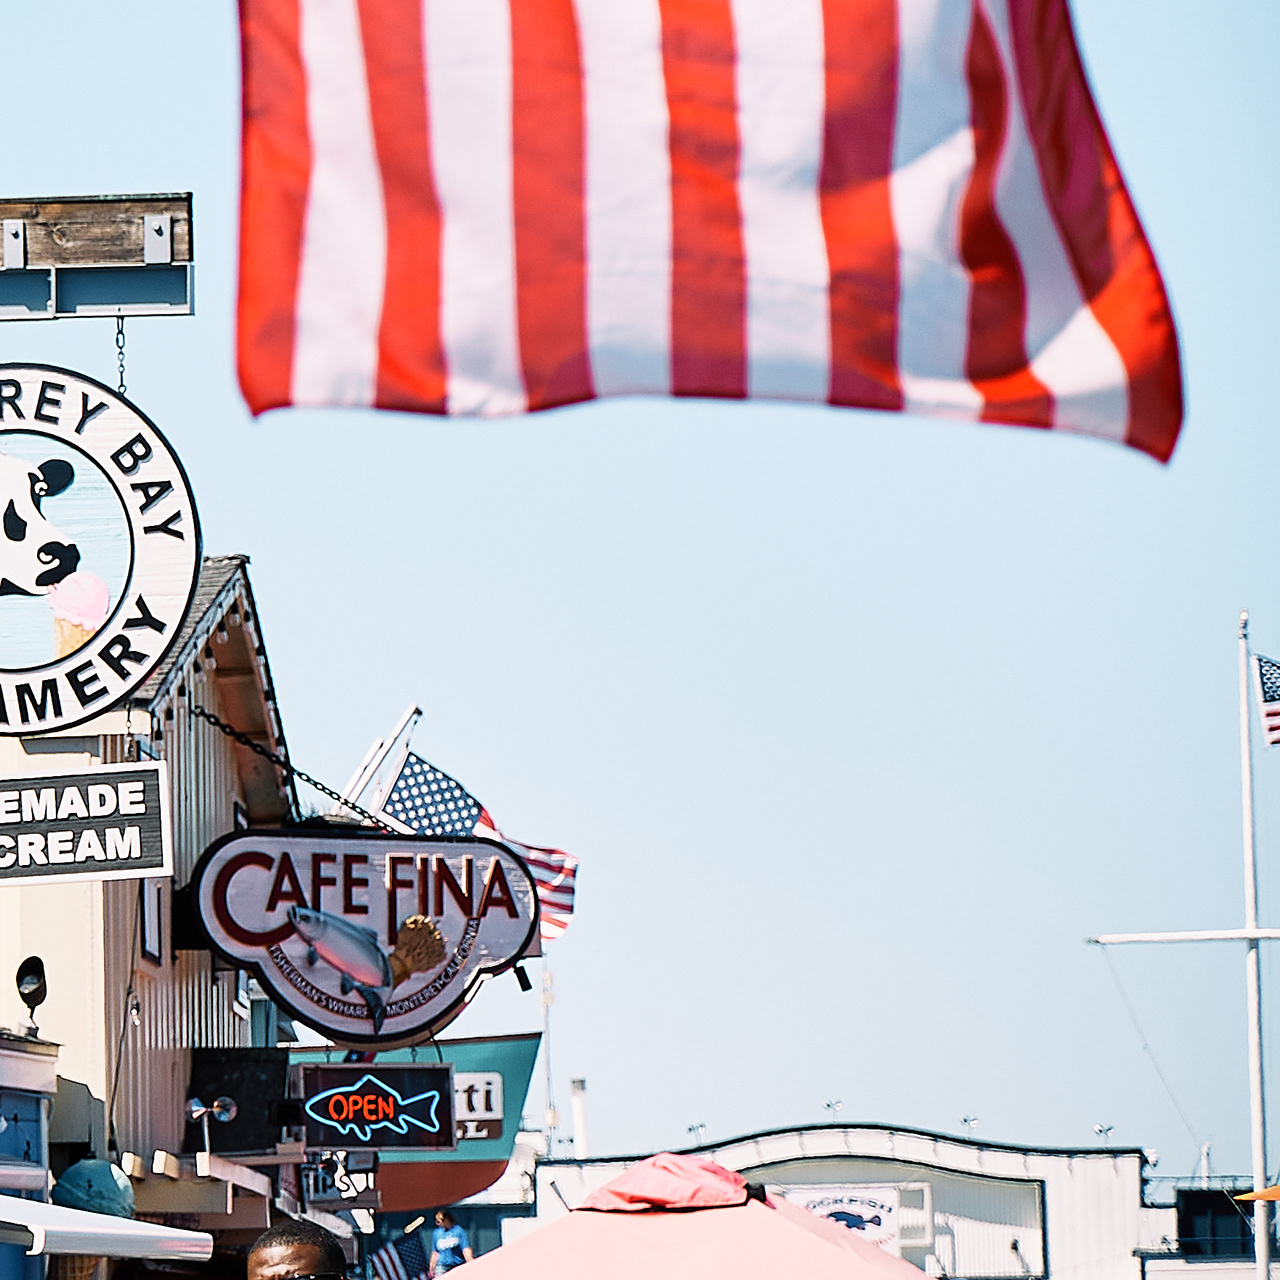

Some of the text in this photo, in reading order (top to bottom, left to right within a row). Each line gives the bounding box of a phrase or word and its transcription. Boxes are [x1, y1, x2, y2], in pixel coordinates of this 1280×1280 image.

[110, 432, 185, 543] BAY
[213, 851, 519, 947] CAFE FINA
[328, 1094, 394, 1121] OPEN
